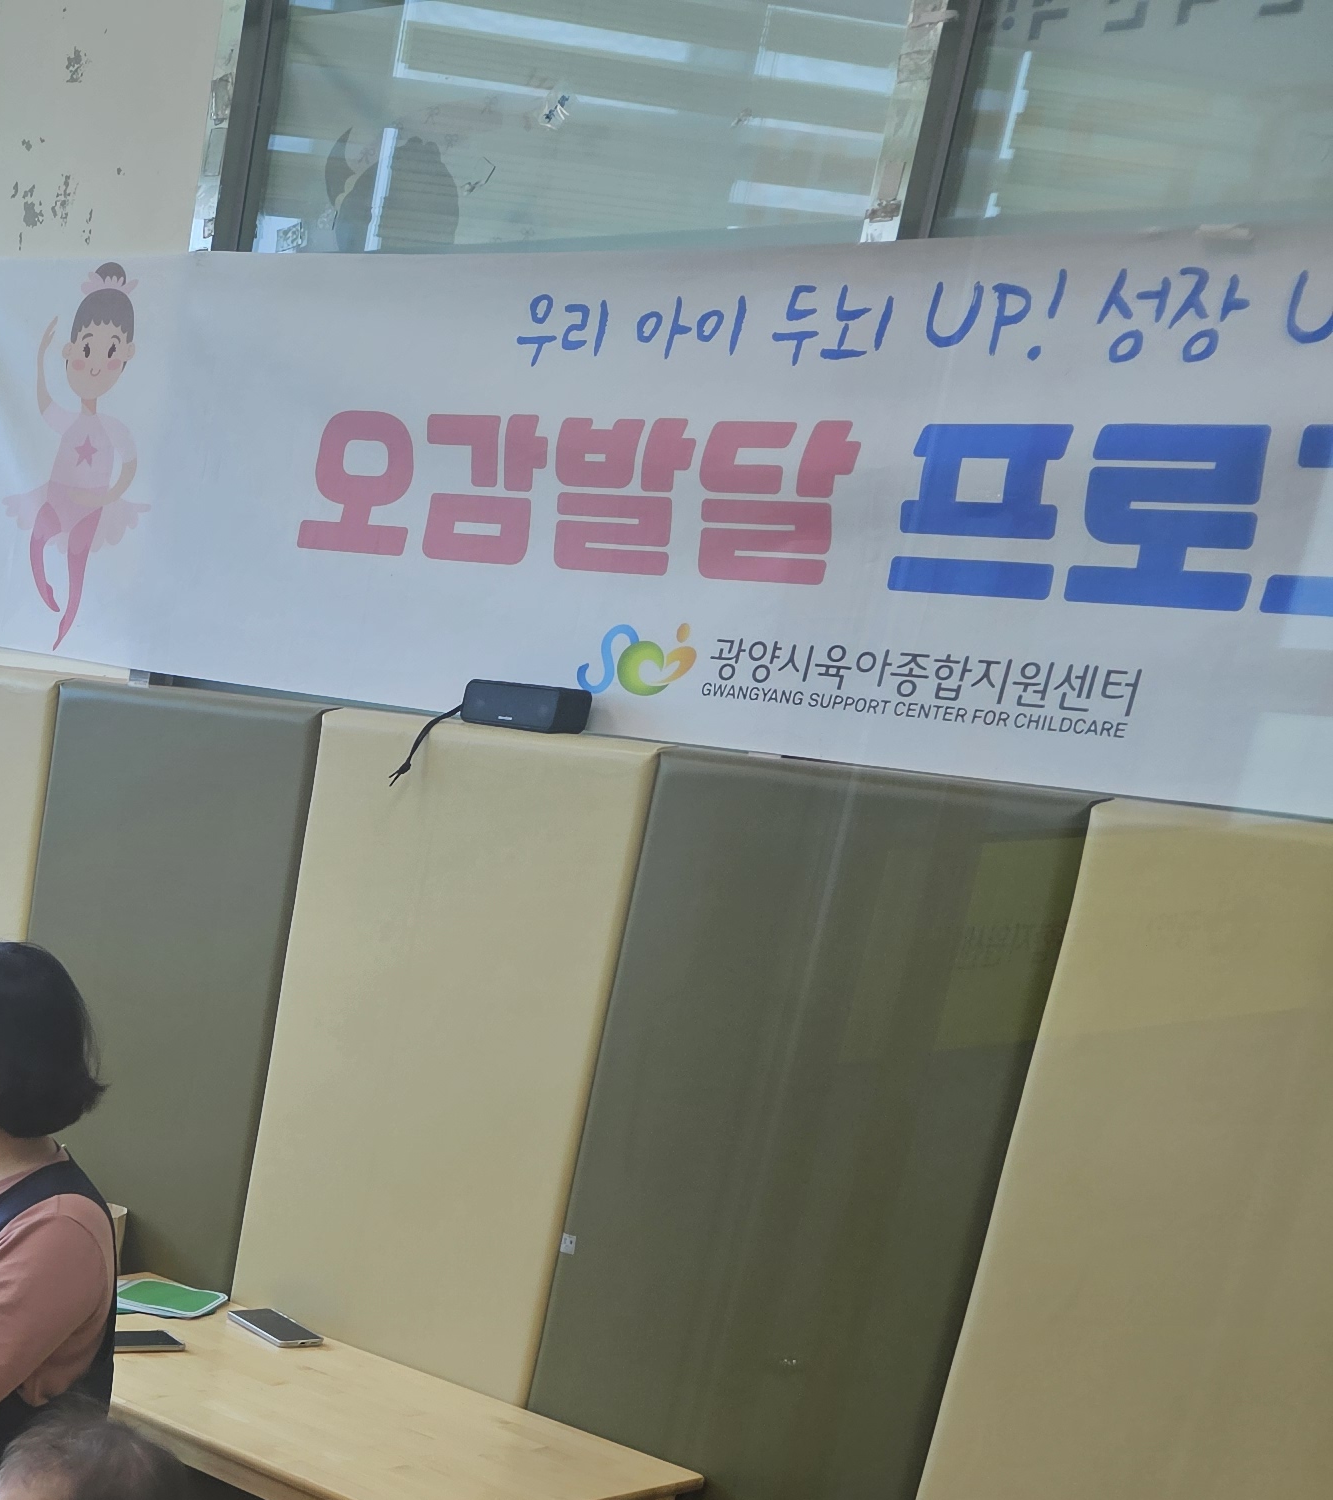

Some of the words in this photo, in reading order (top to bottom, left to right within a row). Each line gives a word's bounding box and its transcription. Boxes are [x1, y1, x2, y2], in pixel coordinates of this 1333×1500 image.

[516, 293, 609, 367] 우리
[636, 295, 747, 360] 아이
[771, 284, 895, 366] 두뇌
[925, 267, 1068, 362] UP!
[1096, 266, 1251, 364] 성장
[296, 409, 863, 586] 오감발달
[701, 681, 805, 706] GWANGYANG
[807, 692, 892, 716] SUPPORT
[893, 700, 968, 724] CENTER
[970, 708, 1011, 728] FOR
[1013, 712, 1129, 739] CHILDCARE
[709, 637, 1143, 718] 광양시육아종합지원센터
